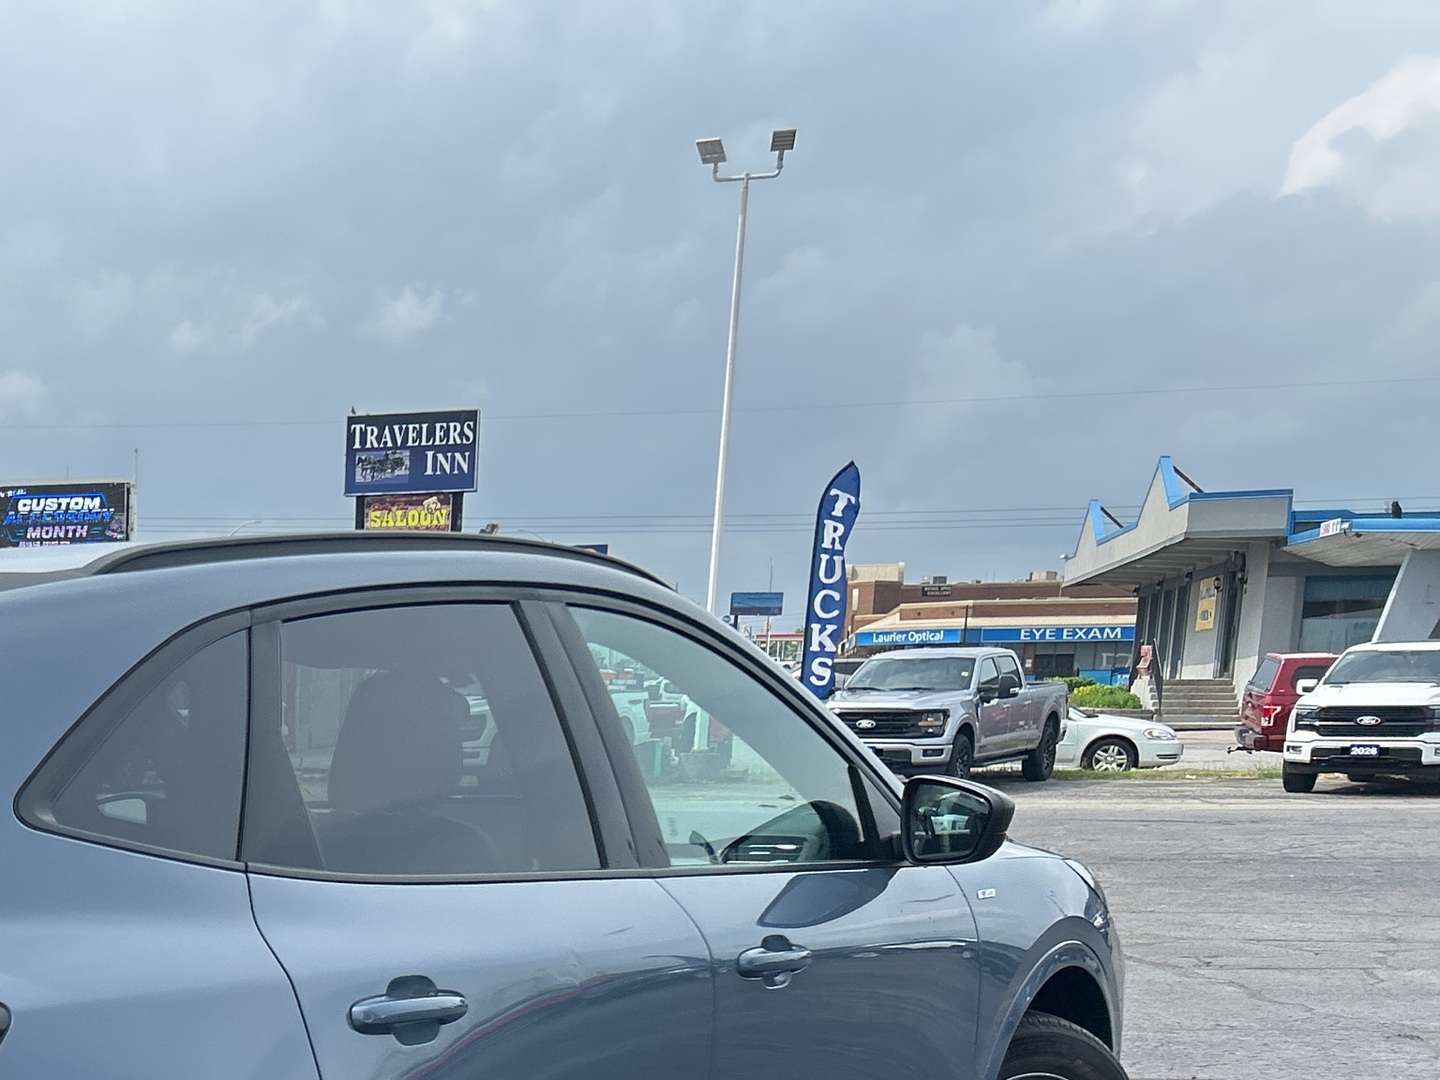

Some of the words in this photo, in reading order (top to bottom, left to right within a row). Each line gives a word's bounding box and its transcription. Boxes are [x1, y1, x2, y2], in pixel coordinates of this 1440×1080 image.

[350, 421, 474, 449] TRAVELERS
[424, 450, 470, 475] INN
[17, 497, 101, 511] CUSTOM
[370, 508, 448, 528] SALOON
[26, 525, 88, 539] MONTH
[809, 488, 856, 686] TRUCKS
[872, 632, 906, 643] Laurier
[908, 631, 944, 644] Optical
[1020, 628, 1056, 640] EYE
[1062, 627, 1122, 640] EXAM
